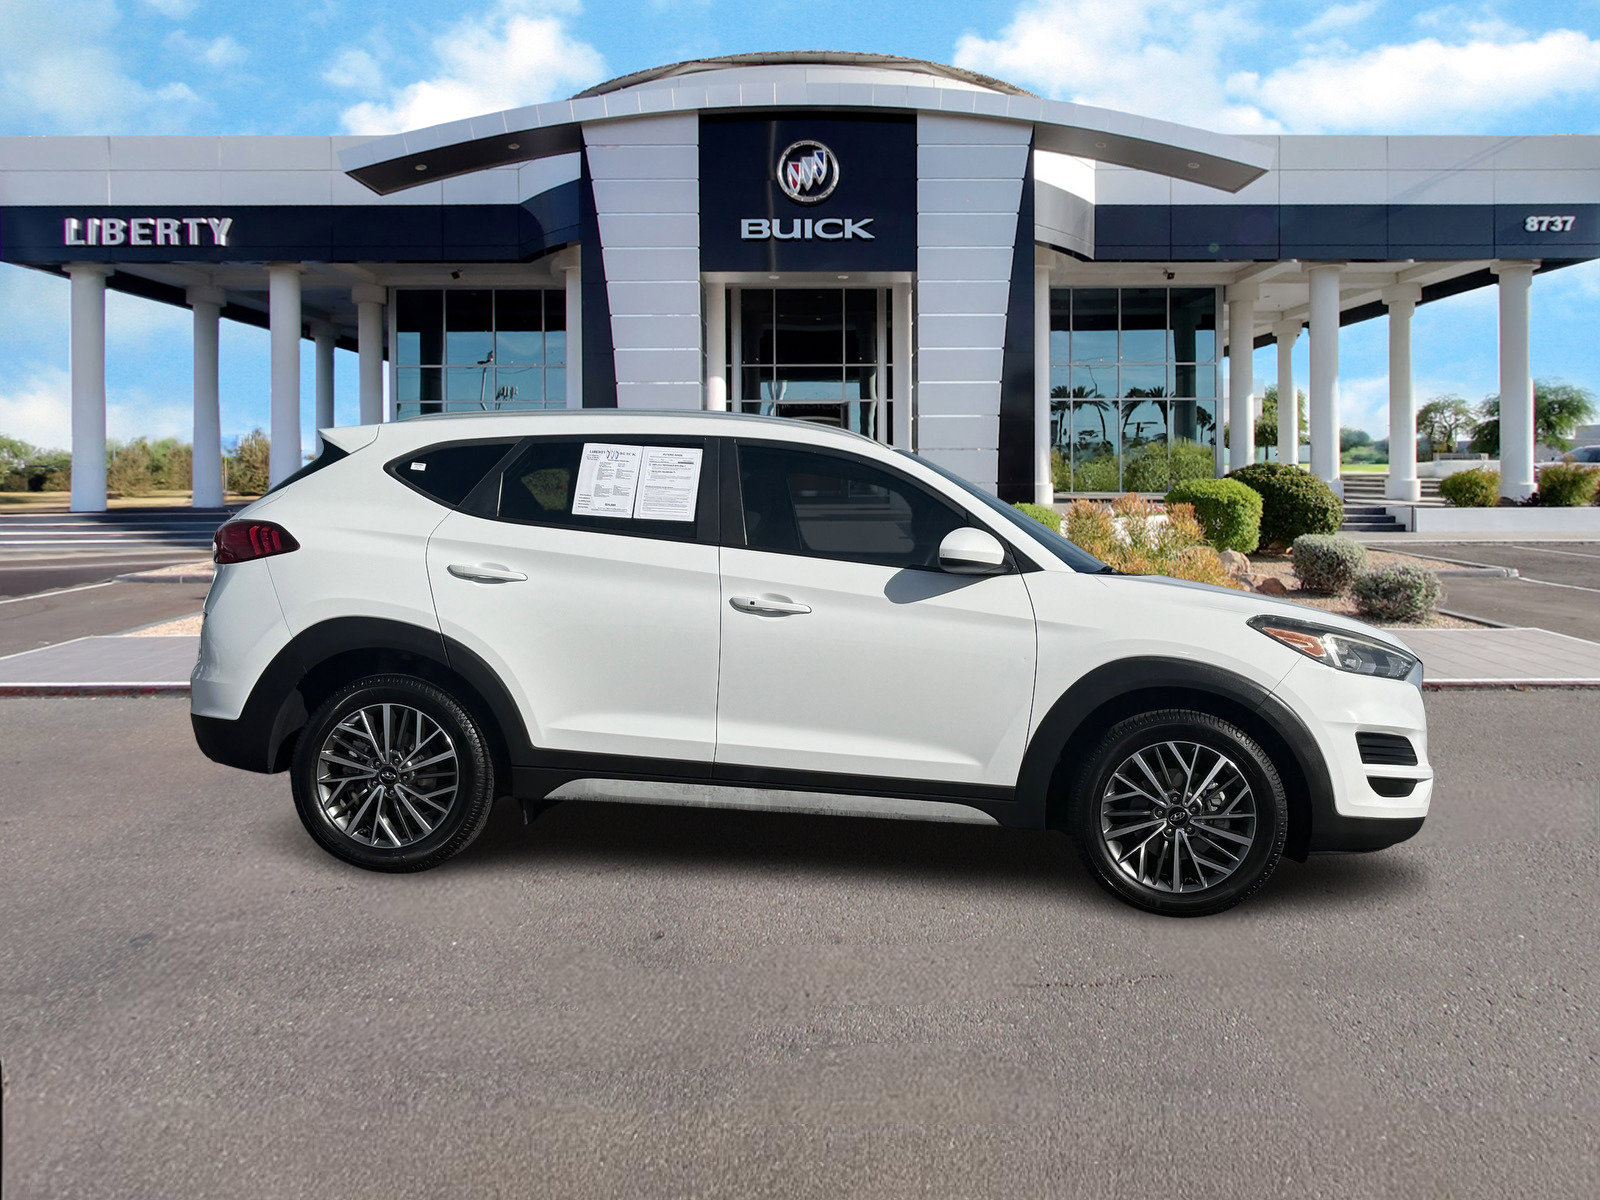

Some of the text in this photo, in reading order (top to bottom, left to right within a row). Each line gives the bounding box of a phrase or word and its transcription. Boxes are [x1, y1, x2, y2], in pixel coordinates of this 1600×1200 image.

[64, 217, 233, 246] LIBERTY
[740, 218, 876, 239] BUICK
[1525, 215, 1576, 232] 8737
